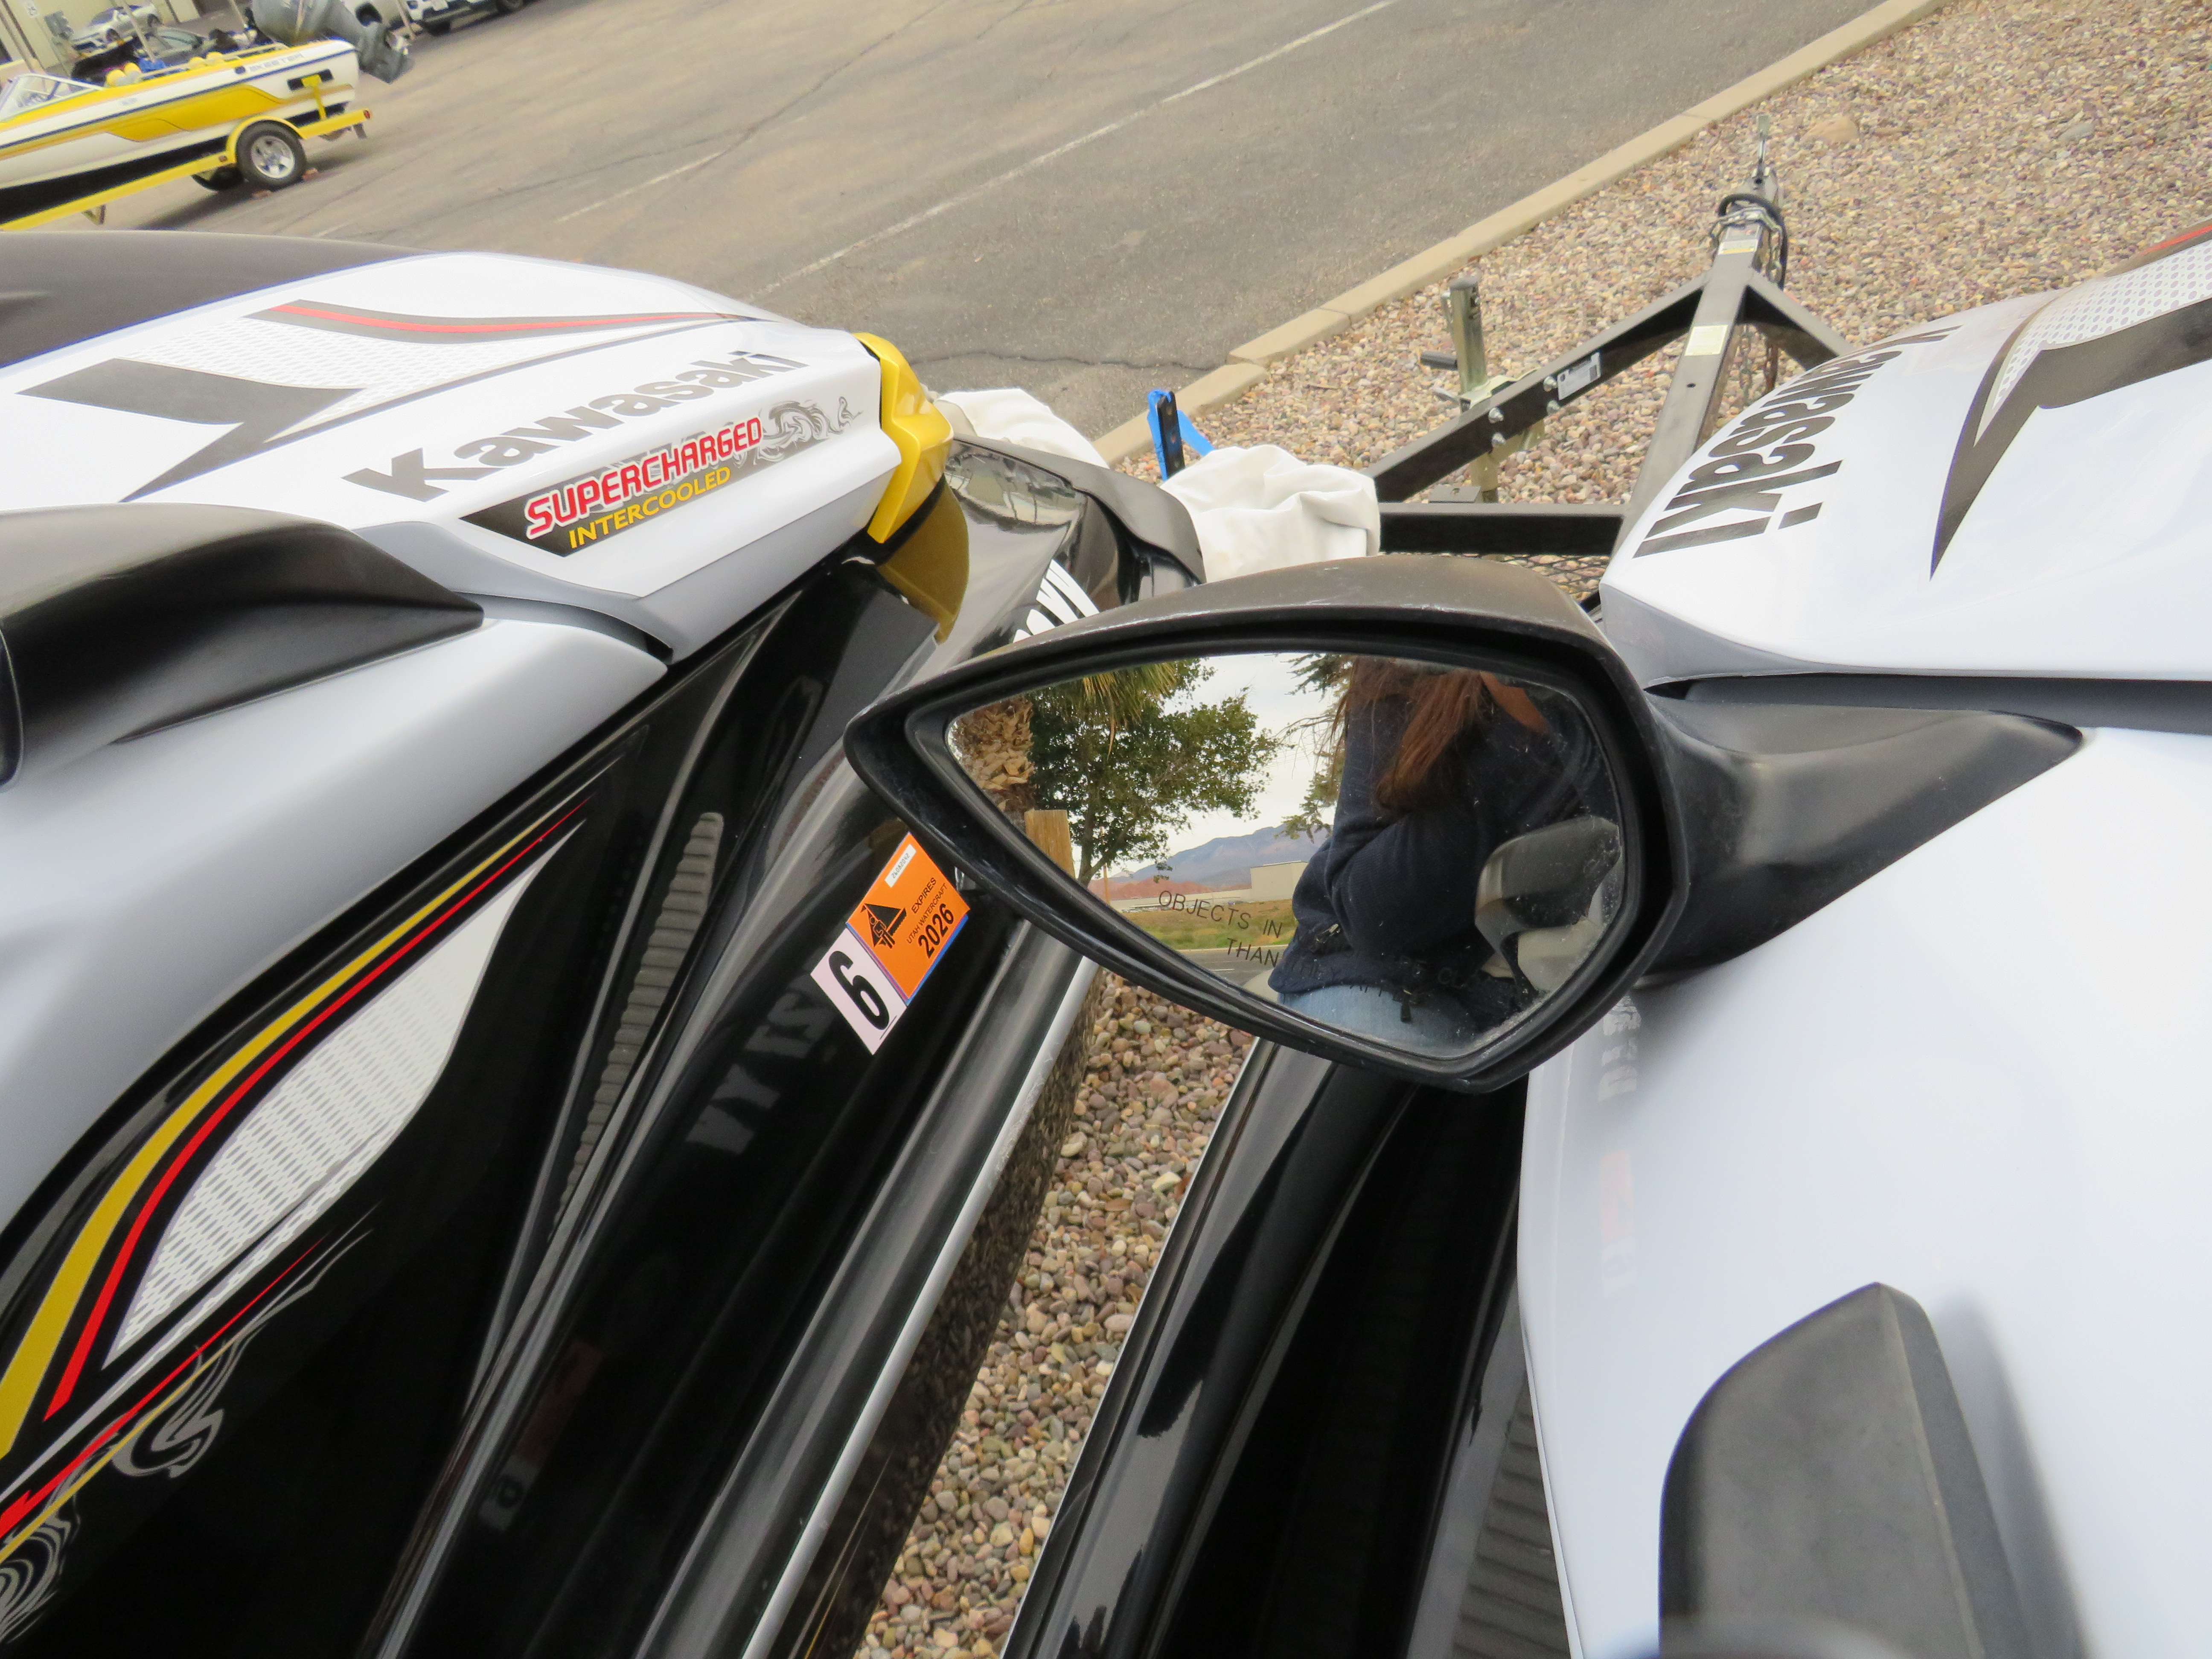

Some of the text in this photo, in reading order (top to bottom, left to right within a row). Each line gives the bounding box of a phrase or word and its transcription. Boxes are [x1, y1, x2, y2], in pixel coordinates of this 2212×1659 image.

[341, 351, 810, 503] Kawasaki
[527, 416, 762, 535] SUPERCHARGED
[569, 466, 731, 549] INTERCOOLED
[906, 882, 947, 944] UTAH WATERCRAFT
[911, 877, 937, 914] EXPIRES
[1158, 890, 1283, 939] OBJECTS IN
[918, 903, 954, 959] 2026
[1227, 937, 1280, 967] THAN
[828, 950, 890, 1030] 6
